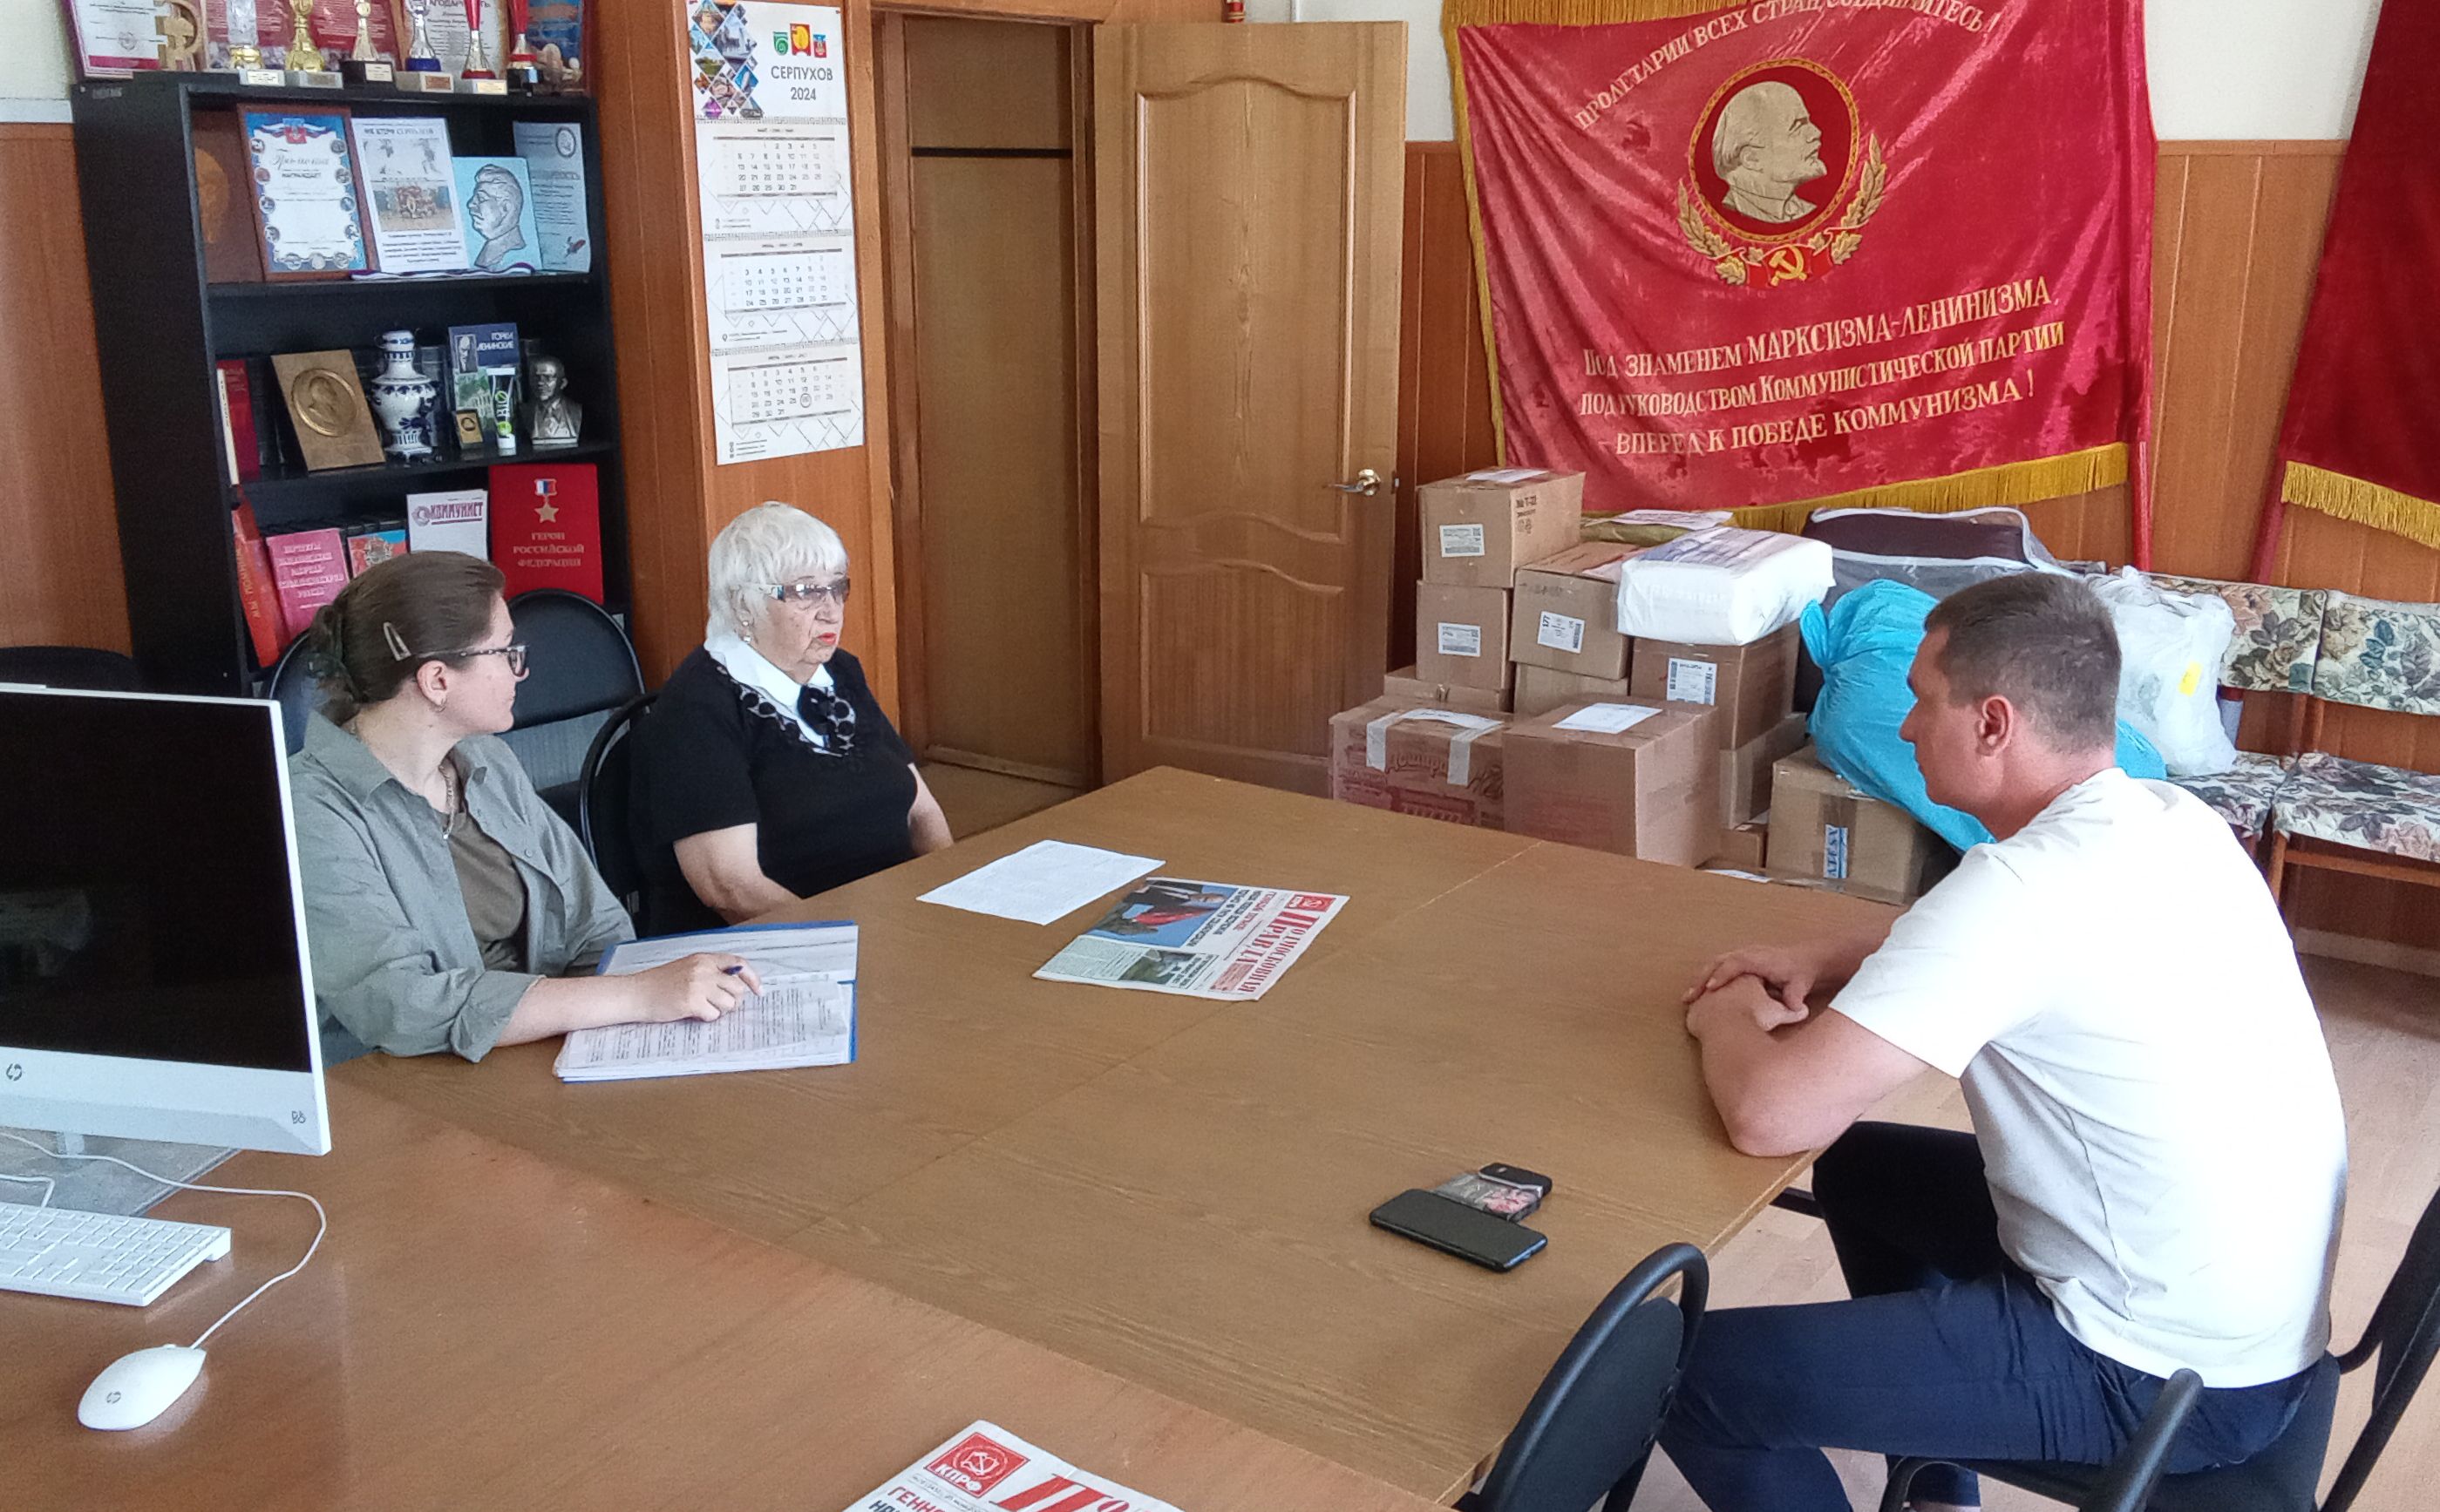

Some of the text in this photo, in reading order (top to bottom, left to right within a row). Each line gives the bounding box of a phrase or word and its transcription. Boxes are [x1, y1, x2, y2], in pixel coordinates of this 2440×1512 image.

[771, 66, 833, 81] СЕРПУХОВ
[1574, 32, 1694, 130] ПРОЛЕТАРИИ
[1694, 9, 1749, 48] ВСЕХ
[791, 87, 817, 100] 2024
[1580, 392, 1616, 416] ПОД
[1978, 322, 2065, 362] ПАРТИИ
[1625, 343, 1743, 376] ЗНАМЕНЕМ
[1615, 431, 1706, 456] ВПЕРЕД
[1706, 429, 1727, 452] К
[1731, 415, 1828, 450] ПОБЕДЕ
[430, 502, 483, 519] КОММУНИСТ
[513, 544, 584, 554] РОССИЙСКОЙ
[517, 558, 581, 567] ФЕДЕРАЦИИ
[935, 1464, 982, 1491] КПРФ
